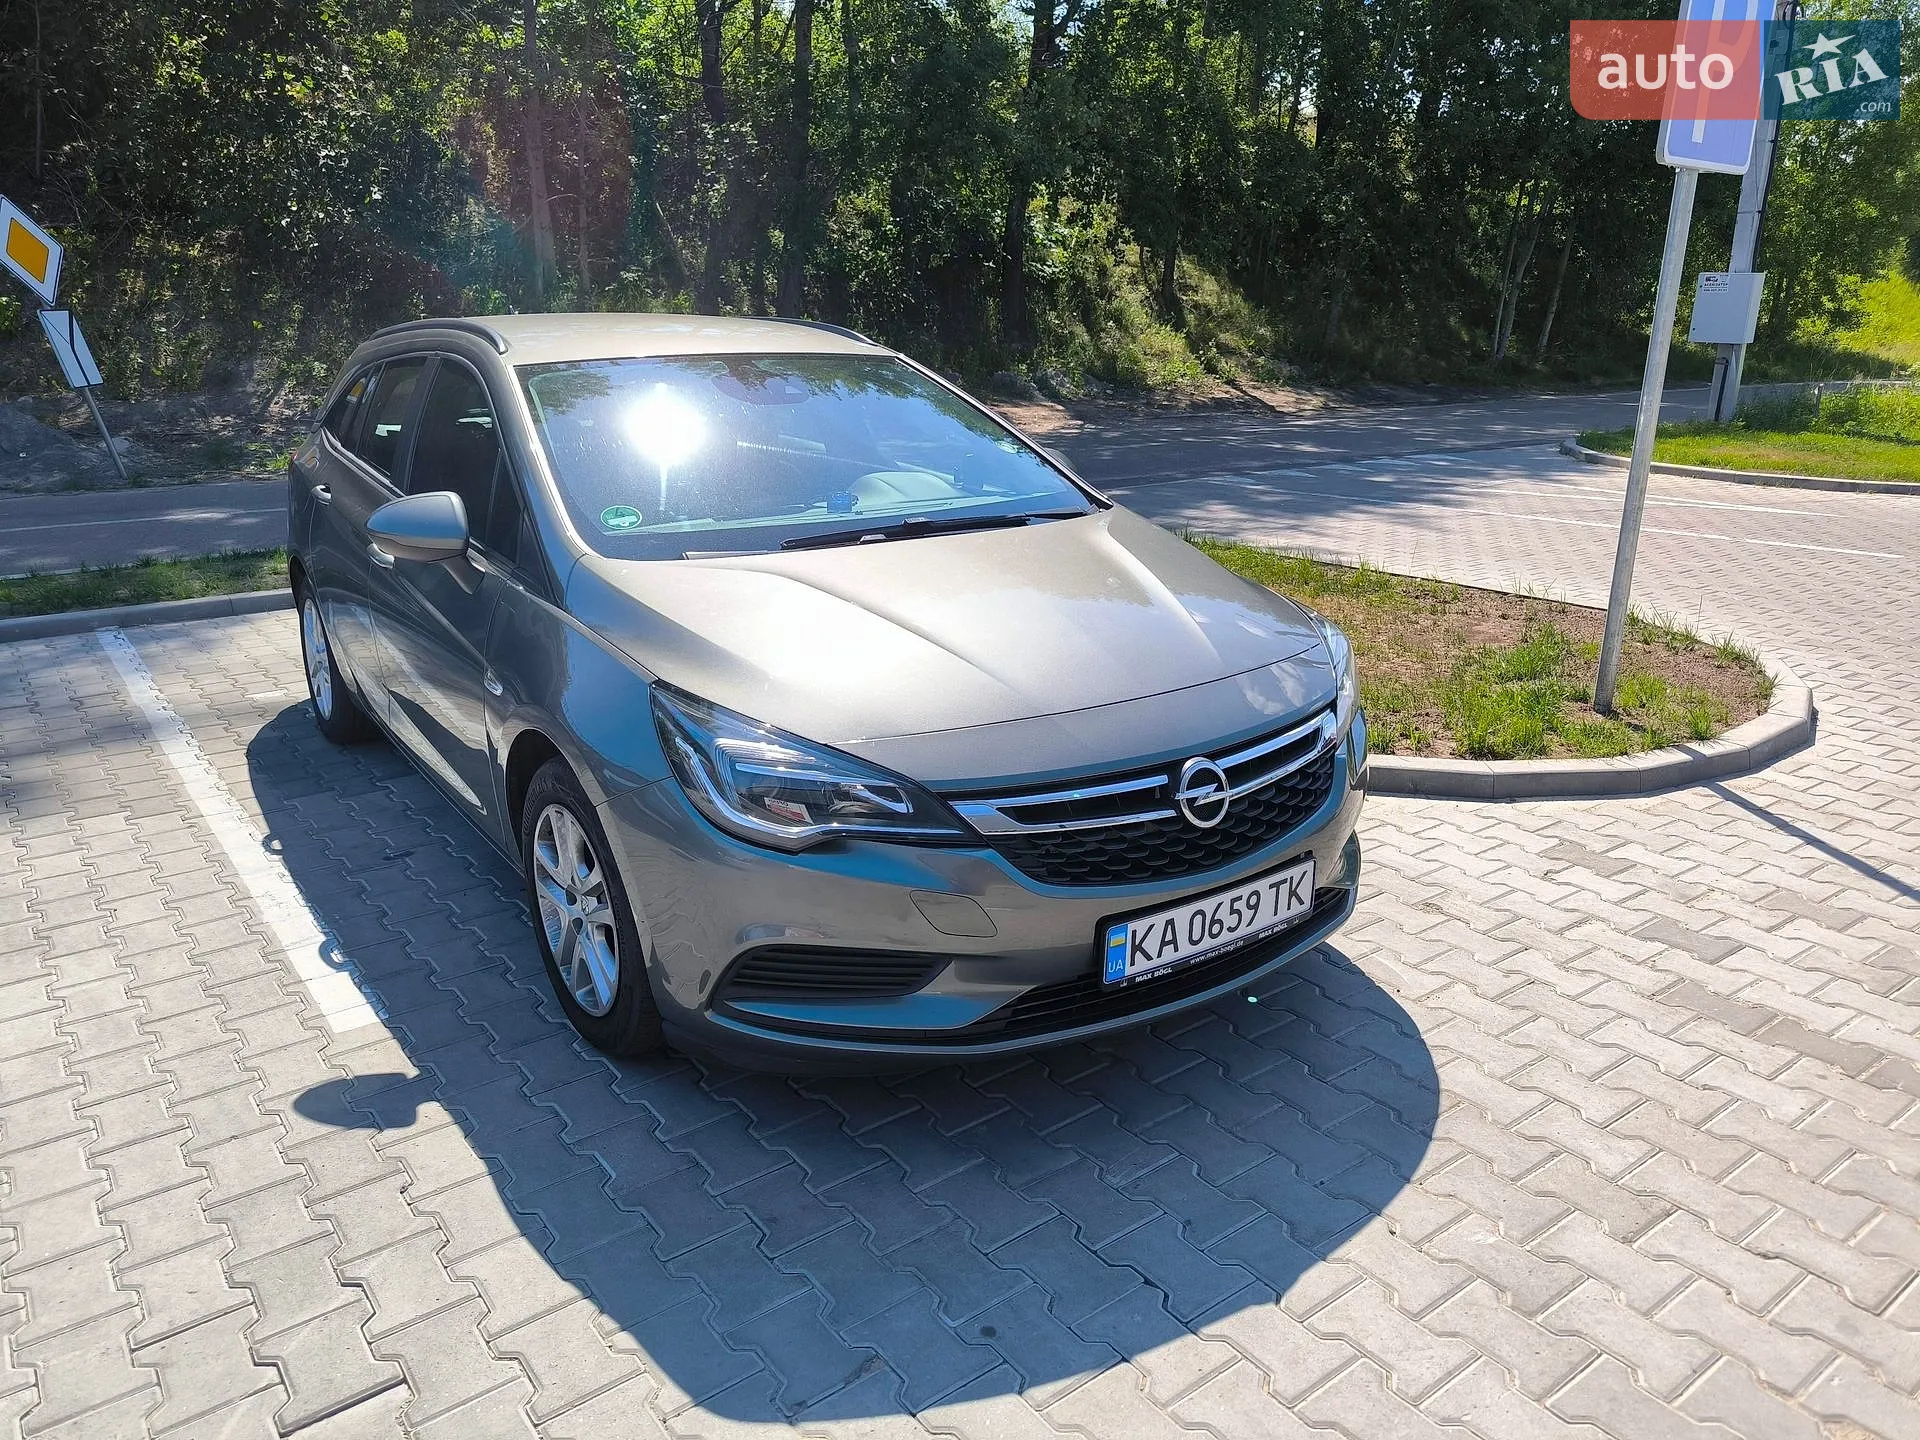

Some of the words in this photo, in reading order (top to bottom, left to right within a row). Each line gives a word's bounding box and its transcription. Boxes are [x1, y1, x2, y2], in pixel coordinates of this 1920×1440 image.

[1129, 917, 1180, 967] KA
[1187, 889, 1262, 947] 0659
[1268, 870, 1308, 917] TK
[1108, 959, 1124, 974] UA
[1135, 973, 1153, 983] MAX
